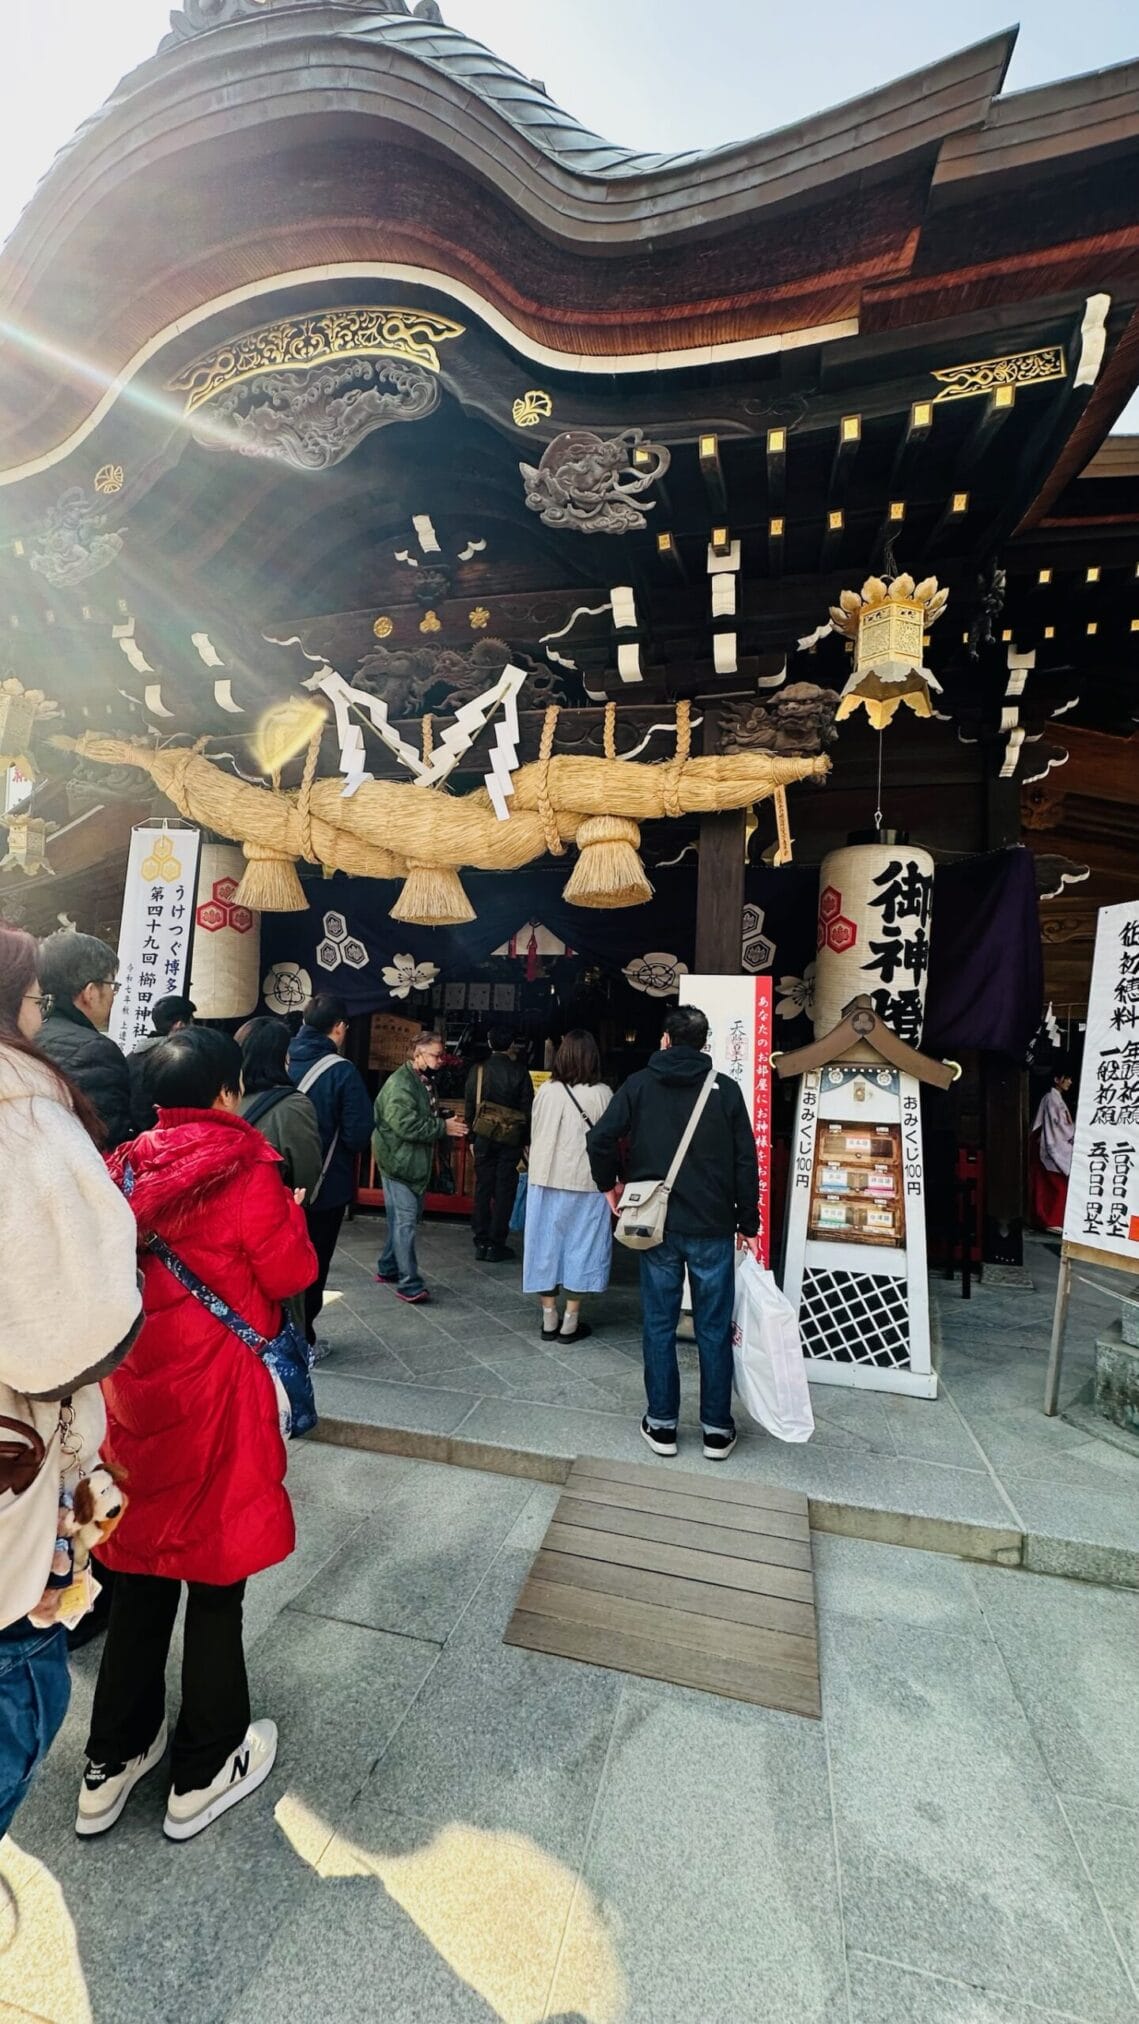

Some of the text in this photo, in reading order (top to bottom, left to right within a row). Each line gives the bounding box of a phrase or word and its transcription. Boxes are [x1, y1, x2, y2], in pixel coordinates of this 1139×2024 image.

[131, 886, 164, 1050] 第四十九回 櫛田神社
[164, 884, 186, 994] うけつぐ博多
[1089, 1046, 1121, 1126] 一般祈願
[795, 1092, 817, 1188] おみくじ100円
[903, 1096, 922, 1196] おみくじ100円
[230, 1750, 250, 1783] N
